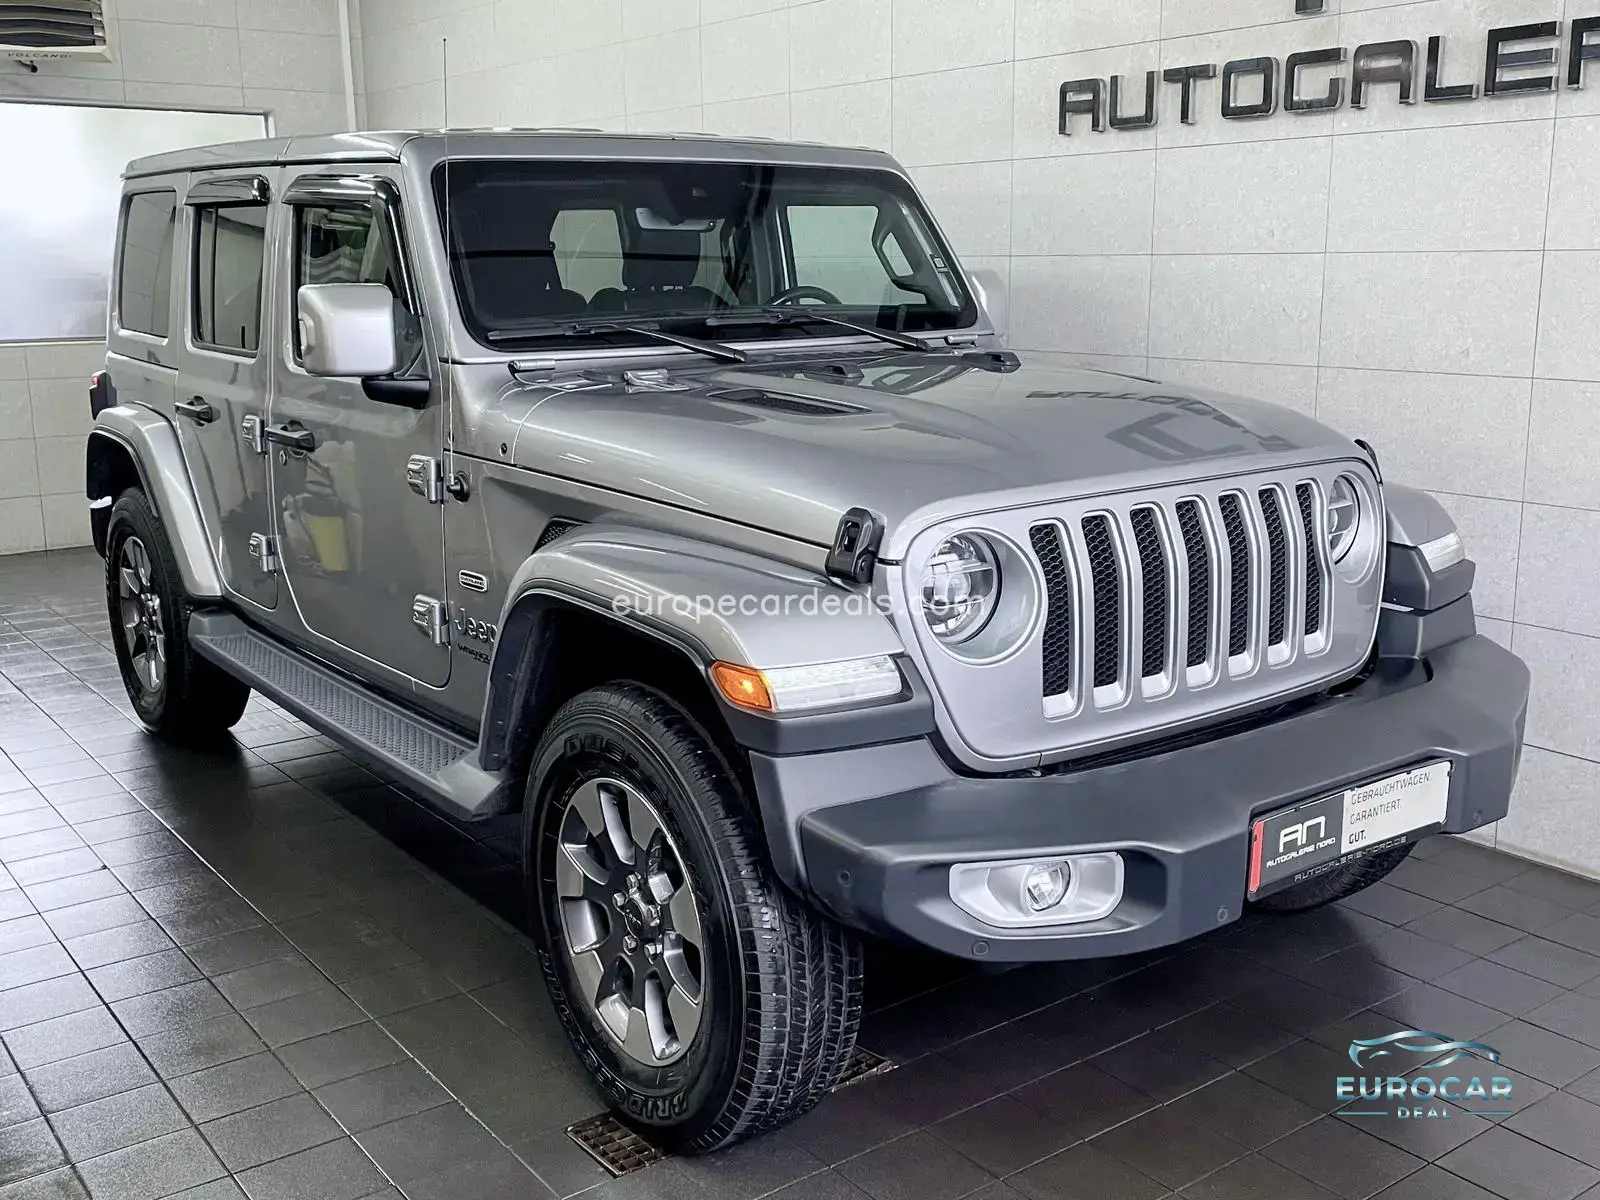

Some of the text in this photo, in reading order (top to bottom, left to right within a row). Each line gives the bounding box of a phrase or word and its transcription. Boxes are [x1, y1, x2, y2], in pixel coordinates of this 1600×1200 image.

[454, 608, 498, 648] Jeep
[1266, 837, 1336, 868] AUTOGALERIE NORD
[1349, 830, 1366, 844] GUT.
